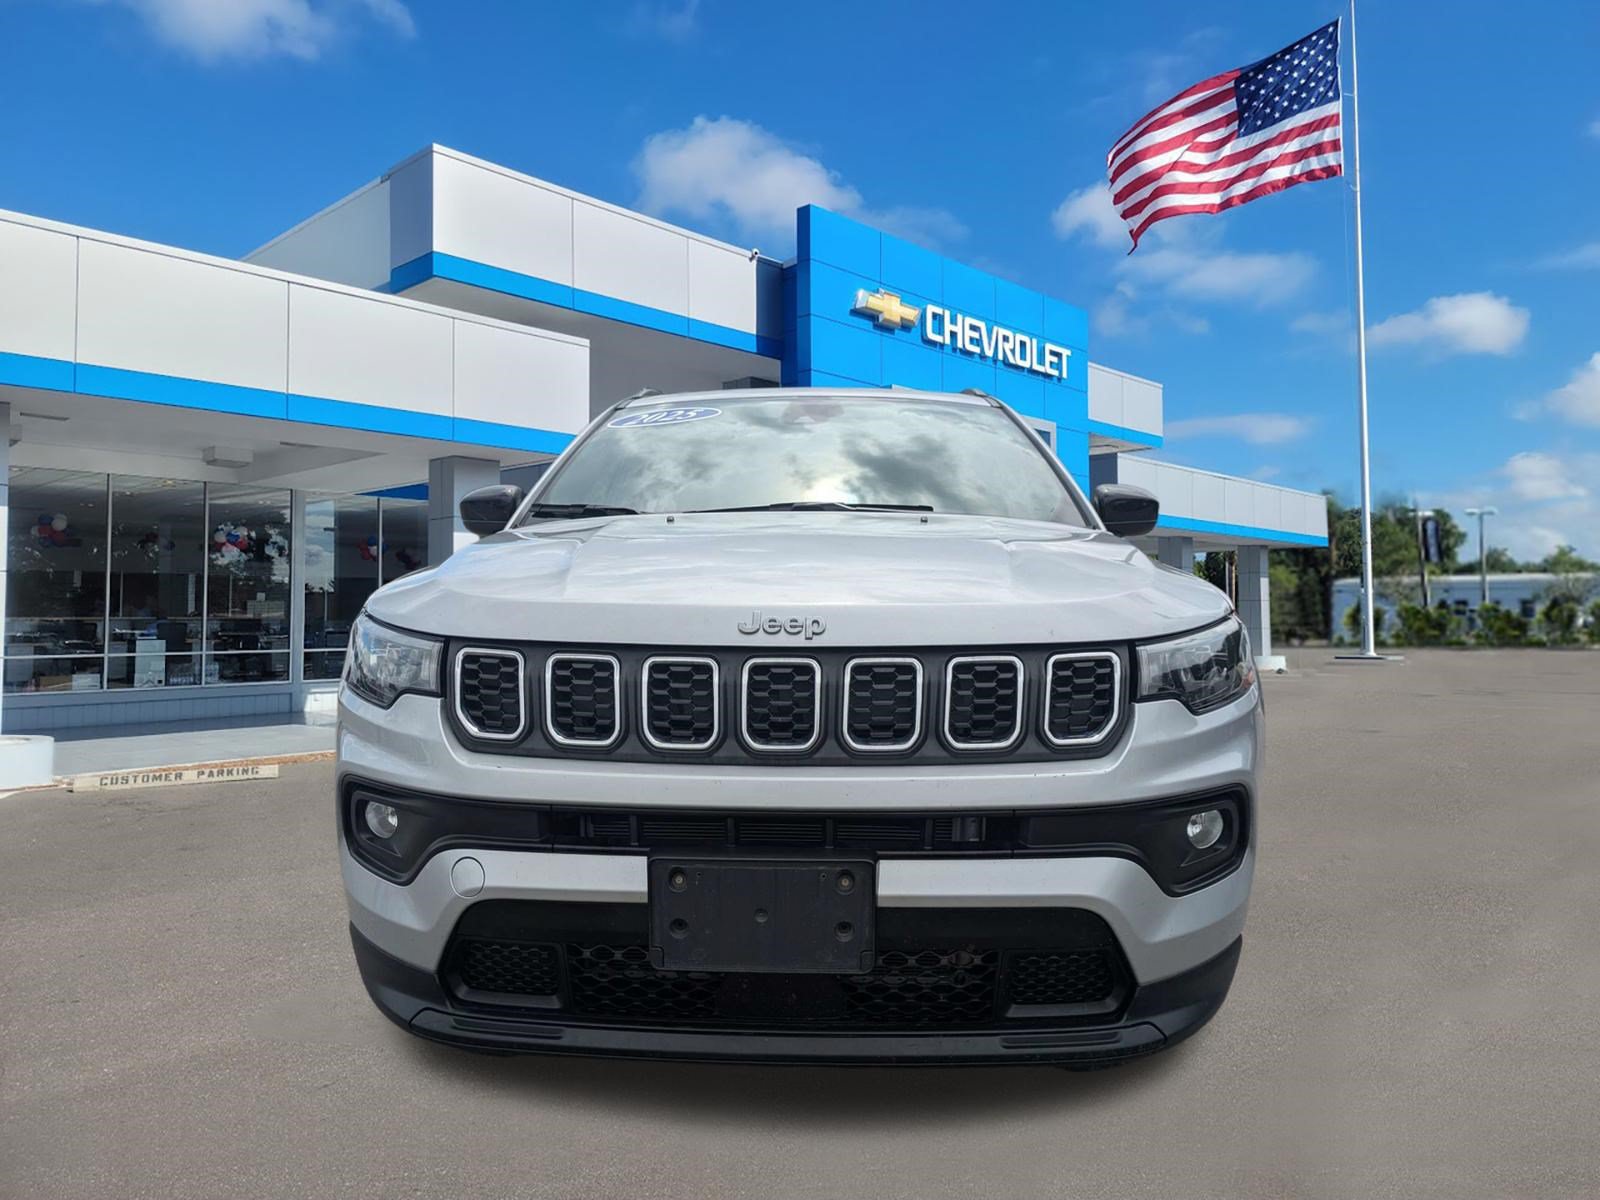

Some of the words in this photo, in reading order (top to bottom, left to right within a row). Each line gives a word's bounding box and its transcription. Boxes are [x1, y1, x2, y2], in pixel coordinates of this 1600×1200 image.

[925, 304, 1072, 379] CHEVROLET
[738, 610, 826, 640] Jeep
[99, 772, 183, 787] CUSTOMER
[197, 766, 259, 779] PARKING
